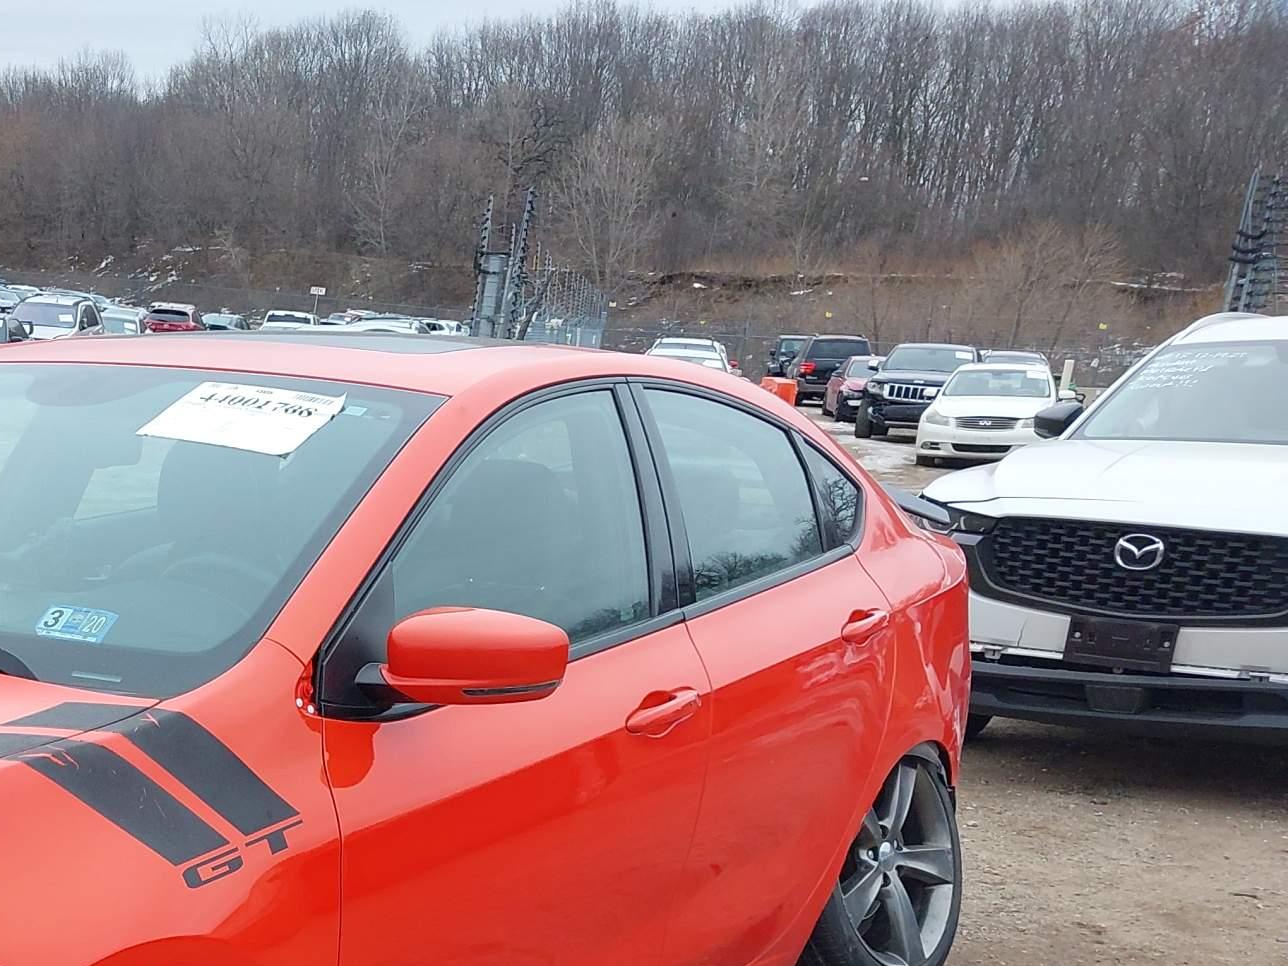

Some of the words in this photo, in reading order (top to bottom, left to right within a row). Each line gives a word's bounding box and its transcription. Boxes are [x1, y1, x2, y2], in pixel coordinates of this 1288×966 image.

[43, 609, 65, 628] 3
[81, 615, 107, 634] 20
[182, 819, 304, 889] GT
